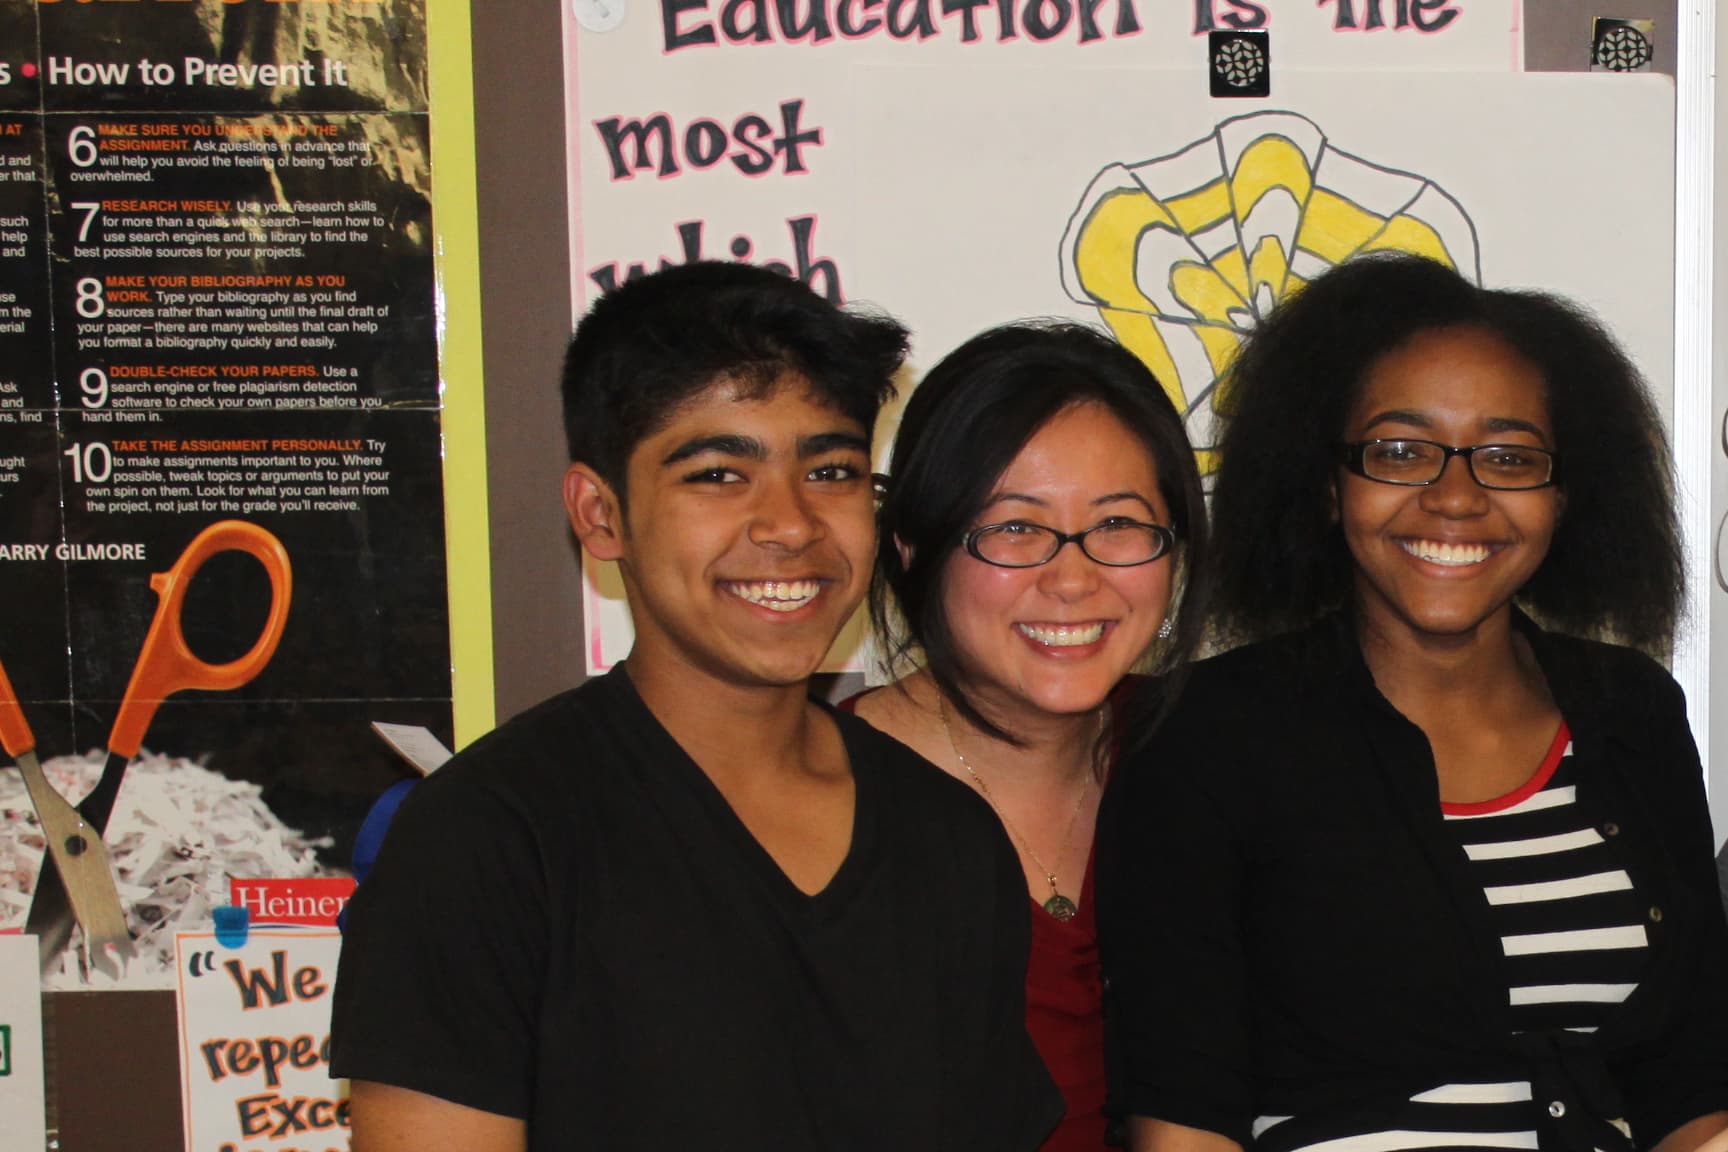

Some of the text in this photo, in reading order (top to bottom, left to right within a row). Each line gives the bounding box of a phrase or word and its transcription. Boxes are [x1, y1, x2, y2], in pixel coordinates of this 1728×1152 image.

[48, 56, 348, 88] How to Prevent It
[98, 124, 138, 136] MAKE
[143, 124, 177, 136] SURE
[182, 124, 212, 136] YOU
[313, 124, 337, 136] THE
[99, 140, 190, 151] ASSIGNMENT.
[592, 97, 824, 183] most
[68, 126, 98, 168] 6
[102, 200, 231, 212] RESEARCH WISELY.
[71, 203, 100, 242] 7
[106, 276, 345, 287] MAKE YOUR BIBLIOGRAPHY AS YOU
[76, 277, 103, 317] 8
[107, 291, 152, 303] WORK.
[110, 366, 317, 377] DOUBLE-CHECK YOUR PAPERS.
[80, 369, 109, 409] 9
[113, 440, 386, 453] TAKE THE ASSIGNMENT PERSONALLY. Try
[64, 442, 112, 483] 10
[113, 455, 382, 468] to make assignments important to you. Where
[114, 470, 389, 483] possible, tweak topics or arguments to put your
[86, 485, 389, 498] own spin on them. Look for what you can learn from
[55, 543, 146, 561] GILMORE
